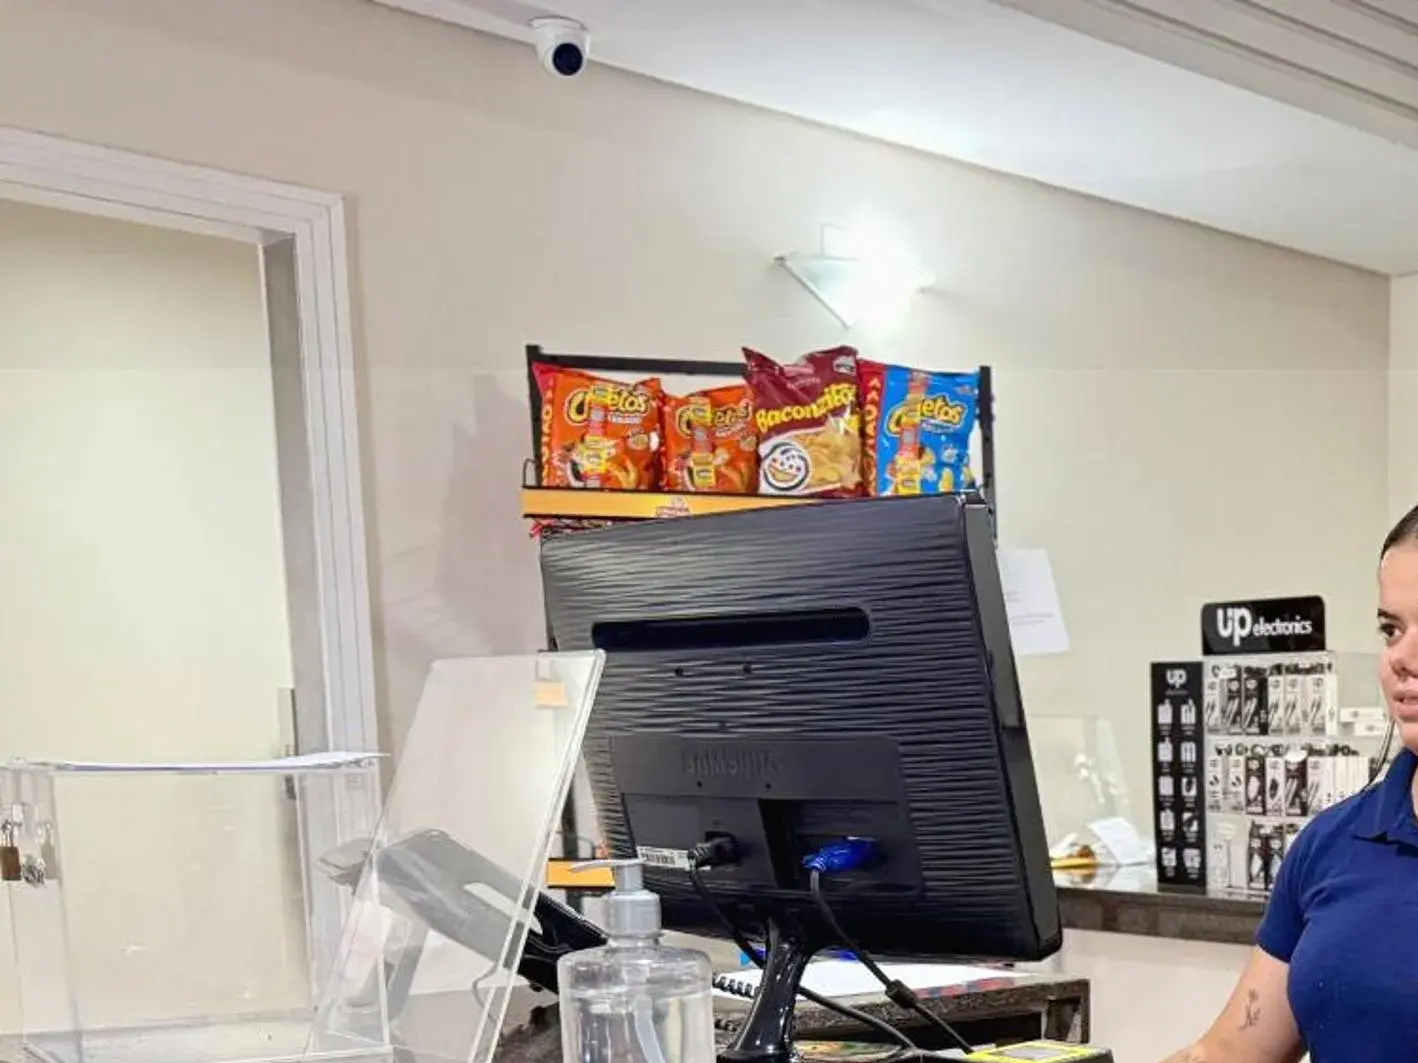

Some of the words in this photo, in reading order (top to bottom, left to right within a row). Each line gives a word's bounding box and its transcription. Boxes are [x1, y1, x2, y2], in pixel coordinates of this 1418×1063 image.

[567, 387, 649, 424] Cetos
[887, 396, 964, 434] Cetos
[1253, 615, 1313, 636] electronics
